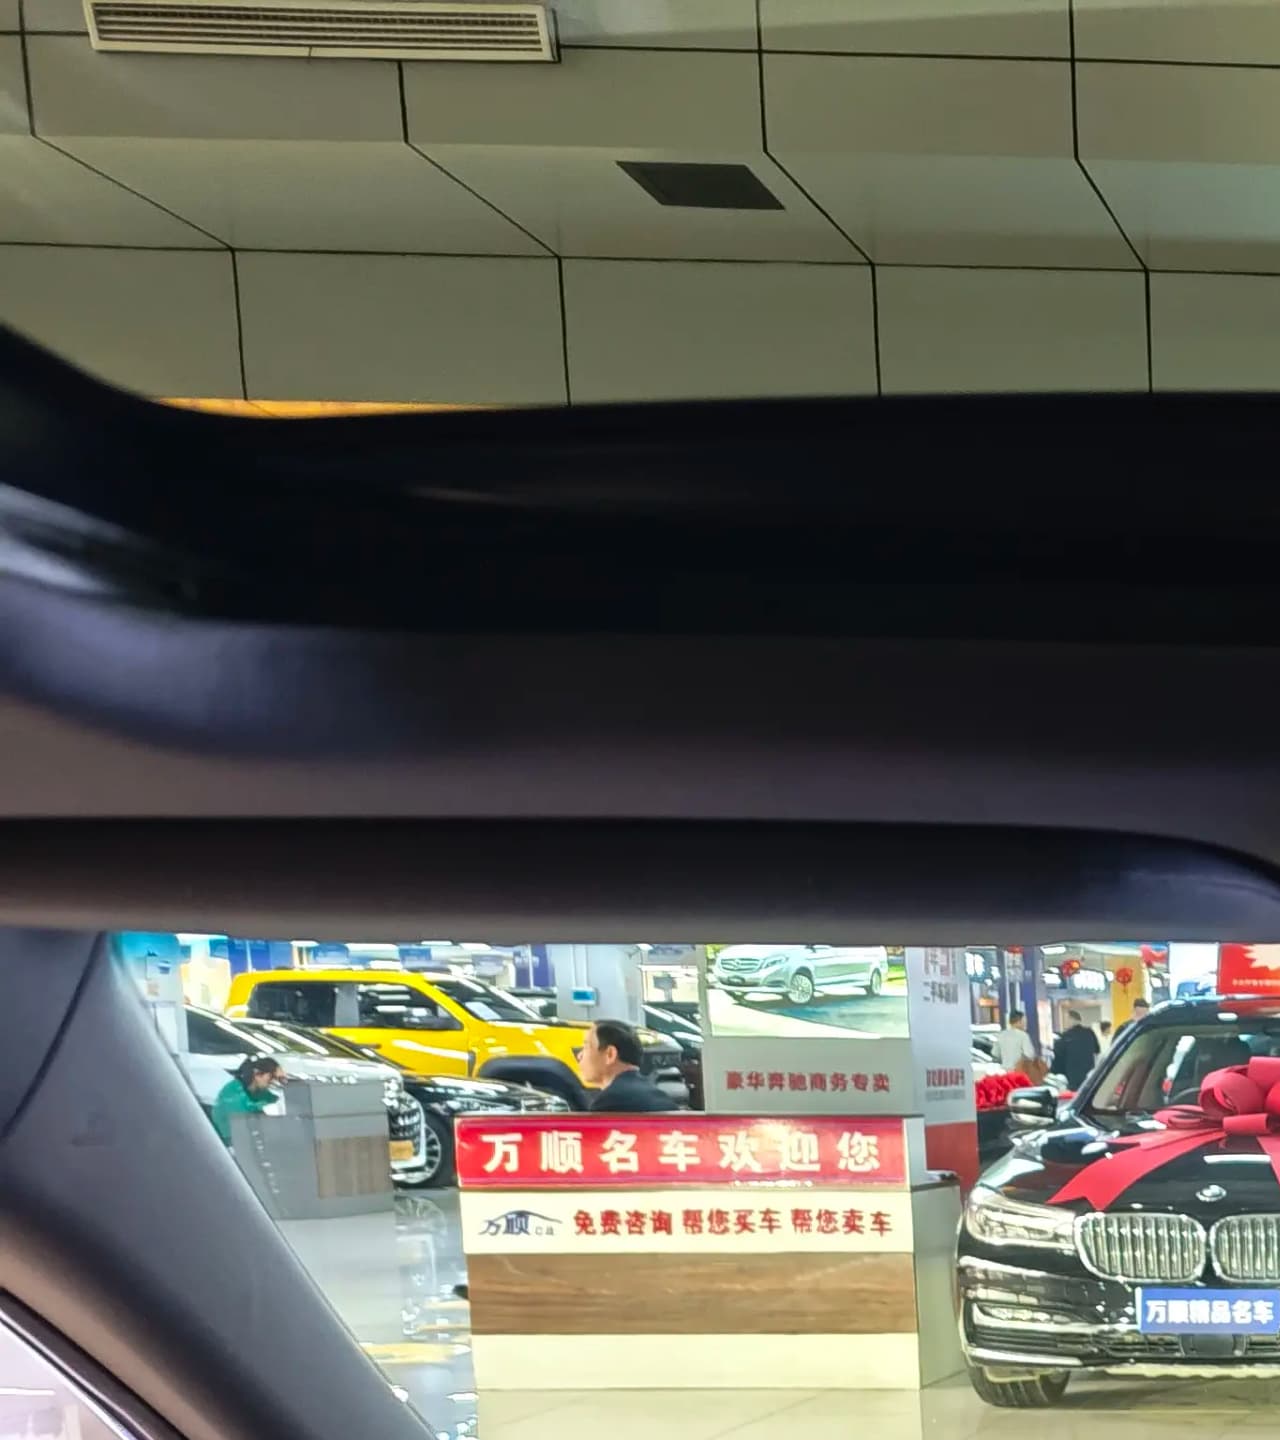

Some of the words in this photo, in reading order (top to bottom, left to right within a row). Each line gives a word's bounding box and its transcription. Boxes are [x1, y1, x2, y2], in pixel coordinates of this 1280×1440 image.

[726, 1070, 890, 1093] 豪华奔驰商务专卖
[480, 1130, 881, 1174] 万顺名车欢迎您
[574, 1209, 673, 1236] 免费咨询
[682, 1207, 782, 1235] 帮您买车
[790, 1208, 893, 1237] 帮您卖车
[1145, 1299, 1275, 1325] 万顺精品名车
